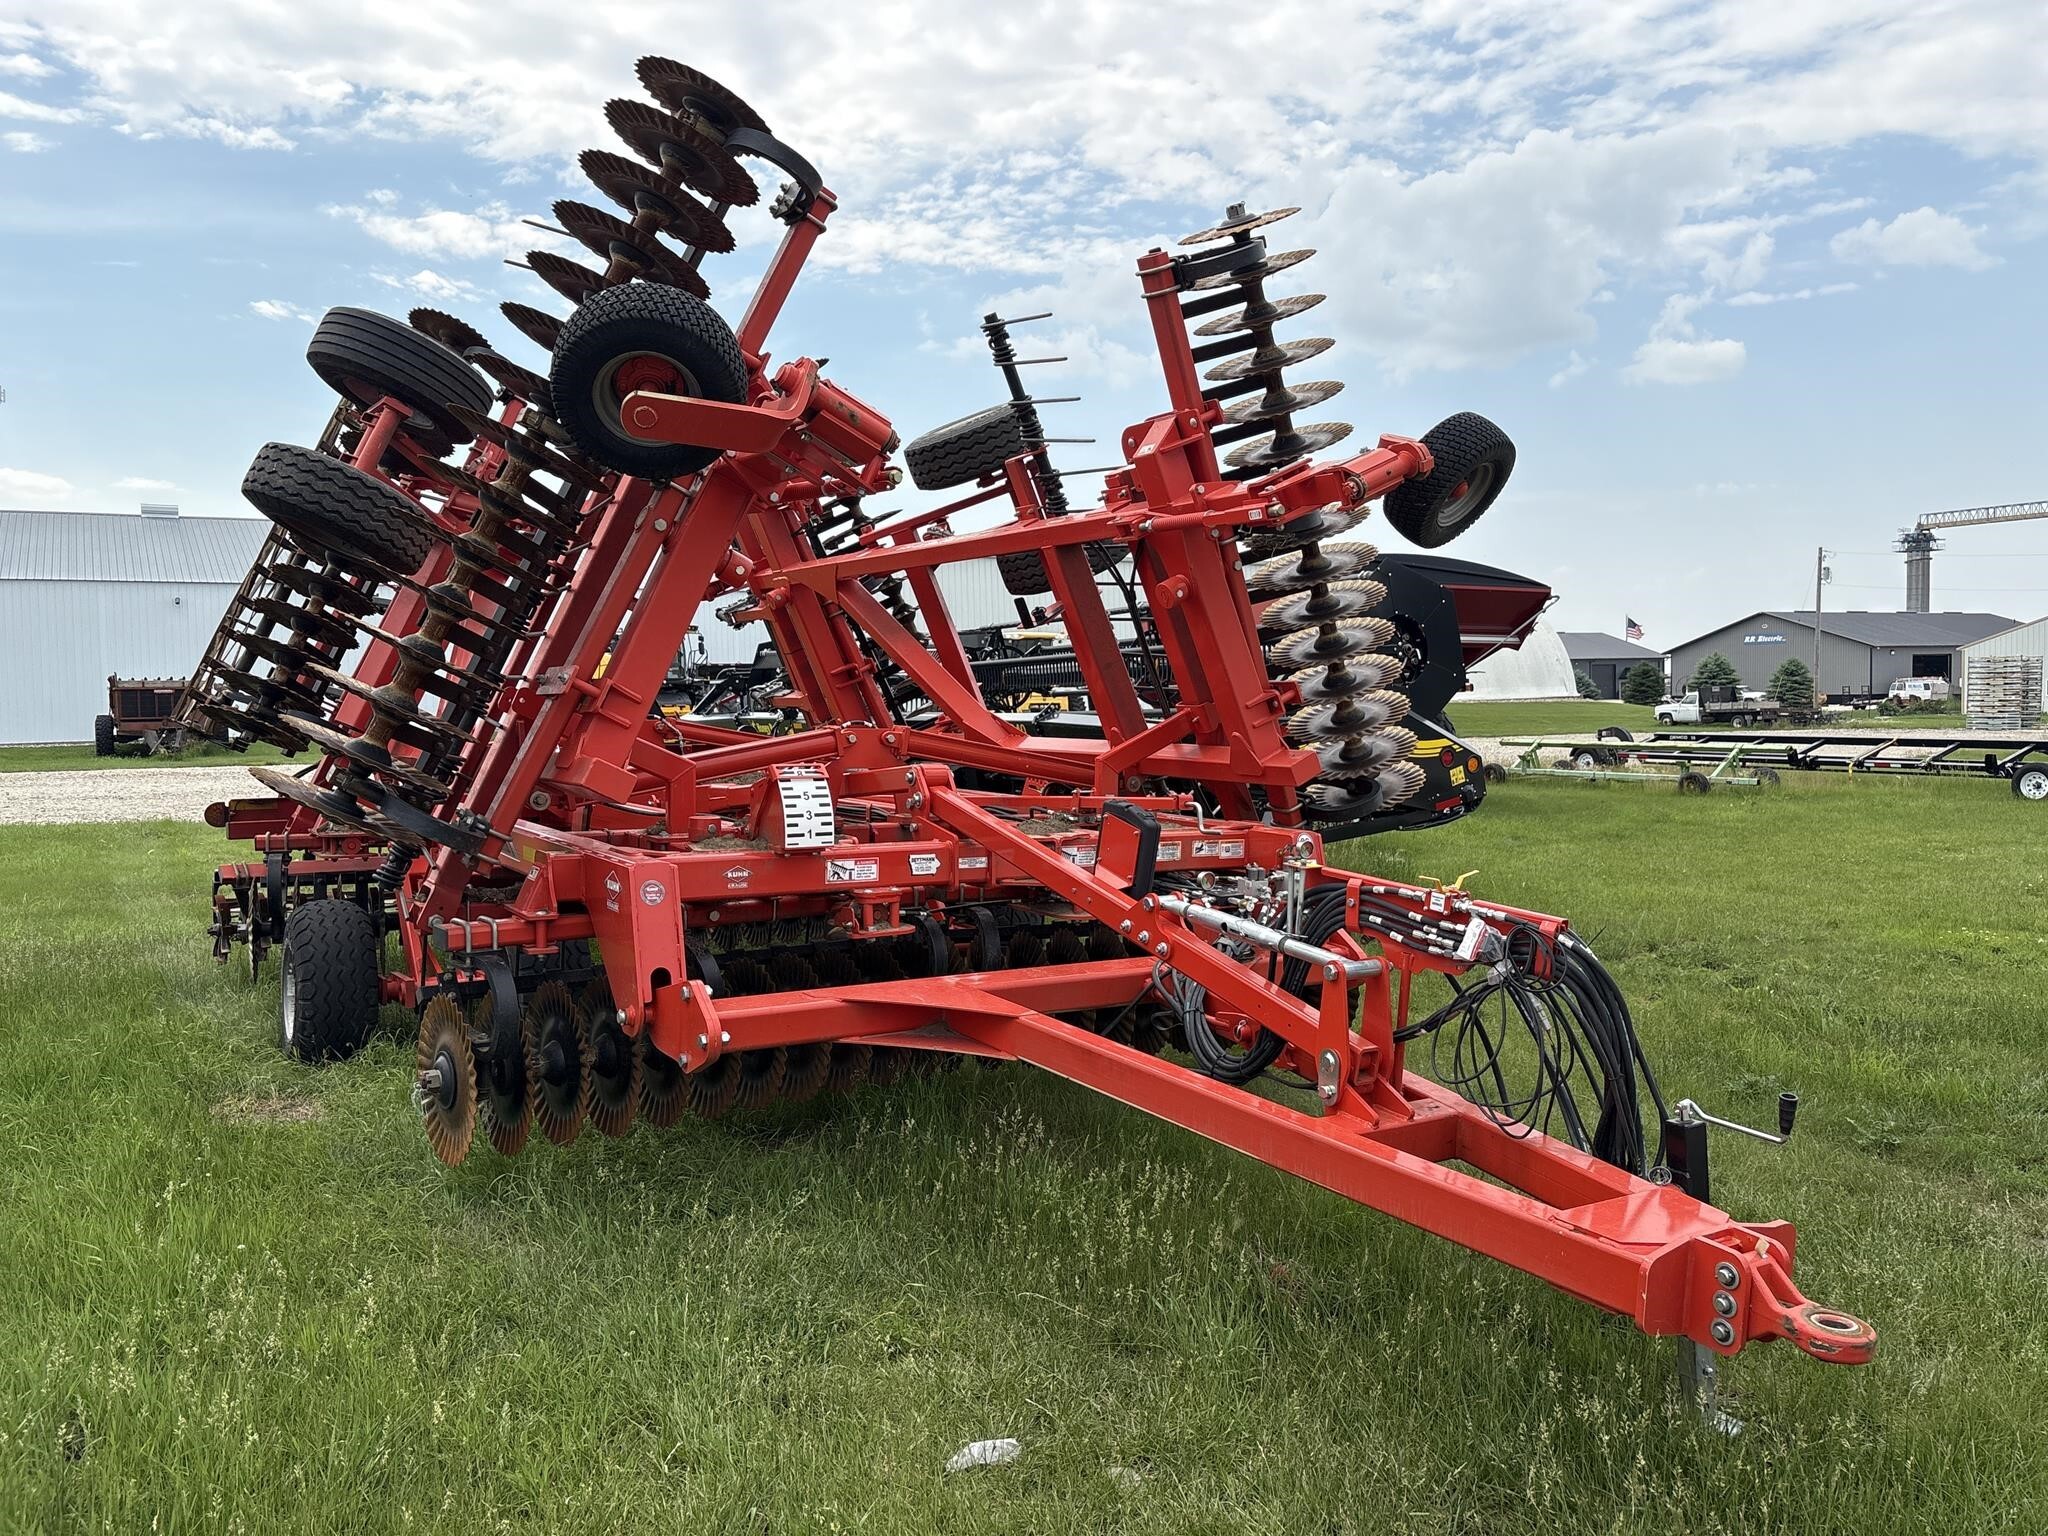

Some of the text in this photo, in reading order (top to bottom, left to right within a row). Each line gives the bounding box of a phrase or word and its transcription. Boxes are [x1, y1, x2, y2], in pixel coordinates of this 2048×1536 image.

[803, 791, 810, 800] 5
[806, 810, 812, 820] 3
[807, 829, 812, 839] 1
